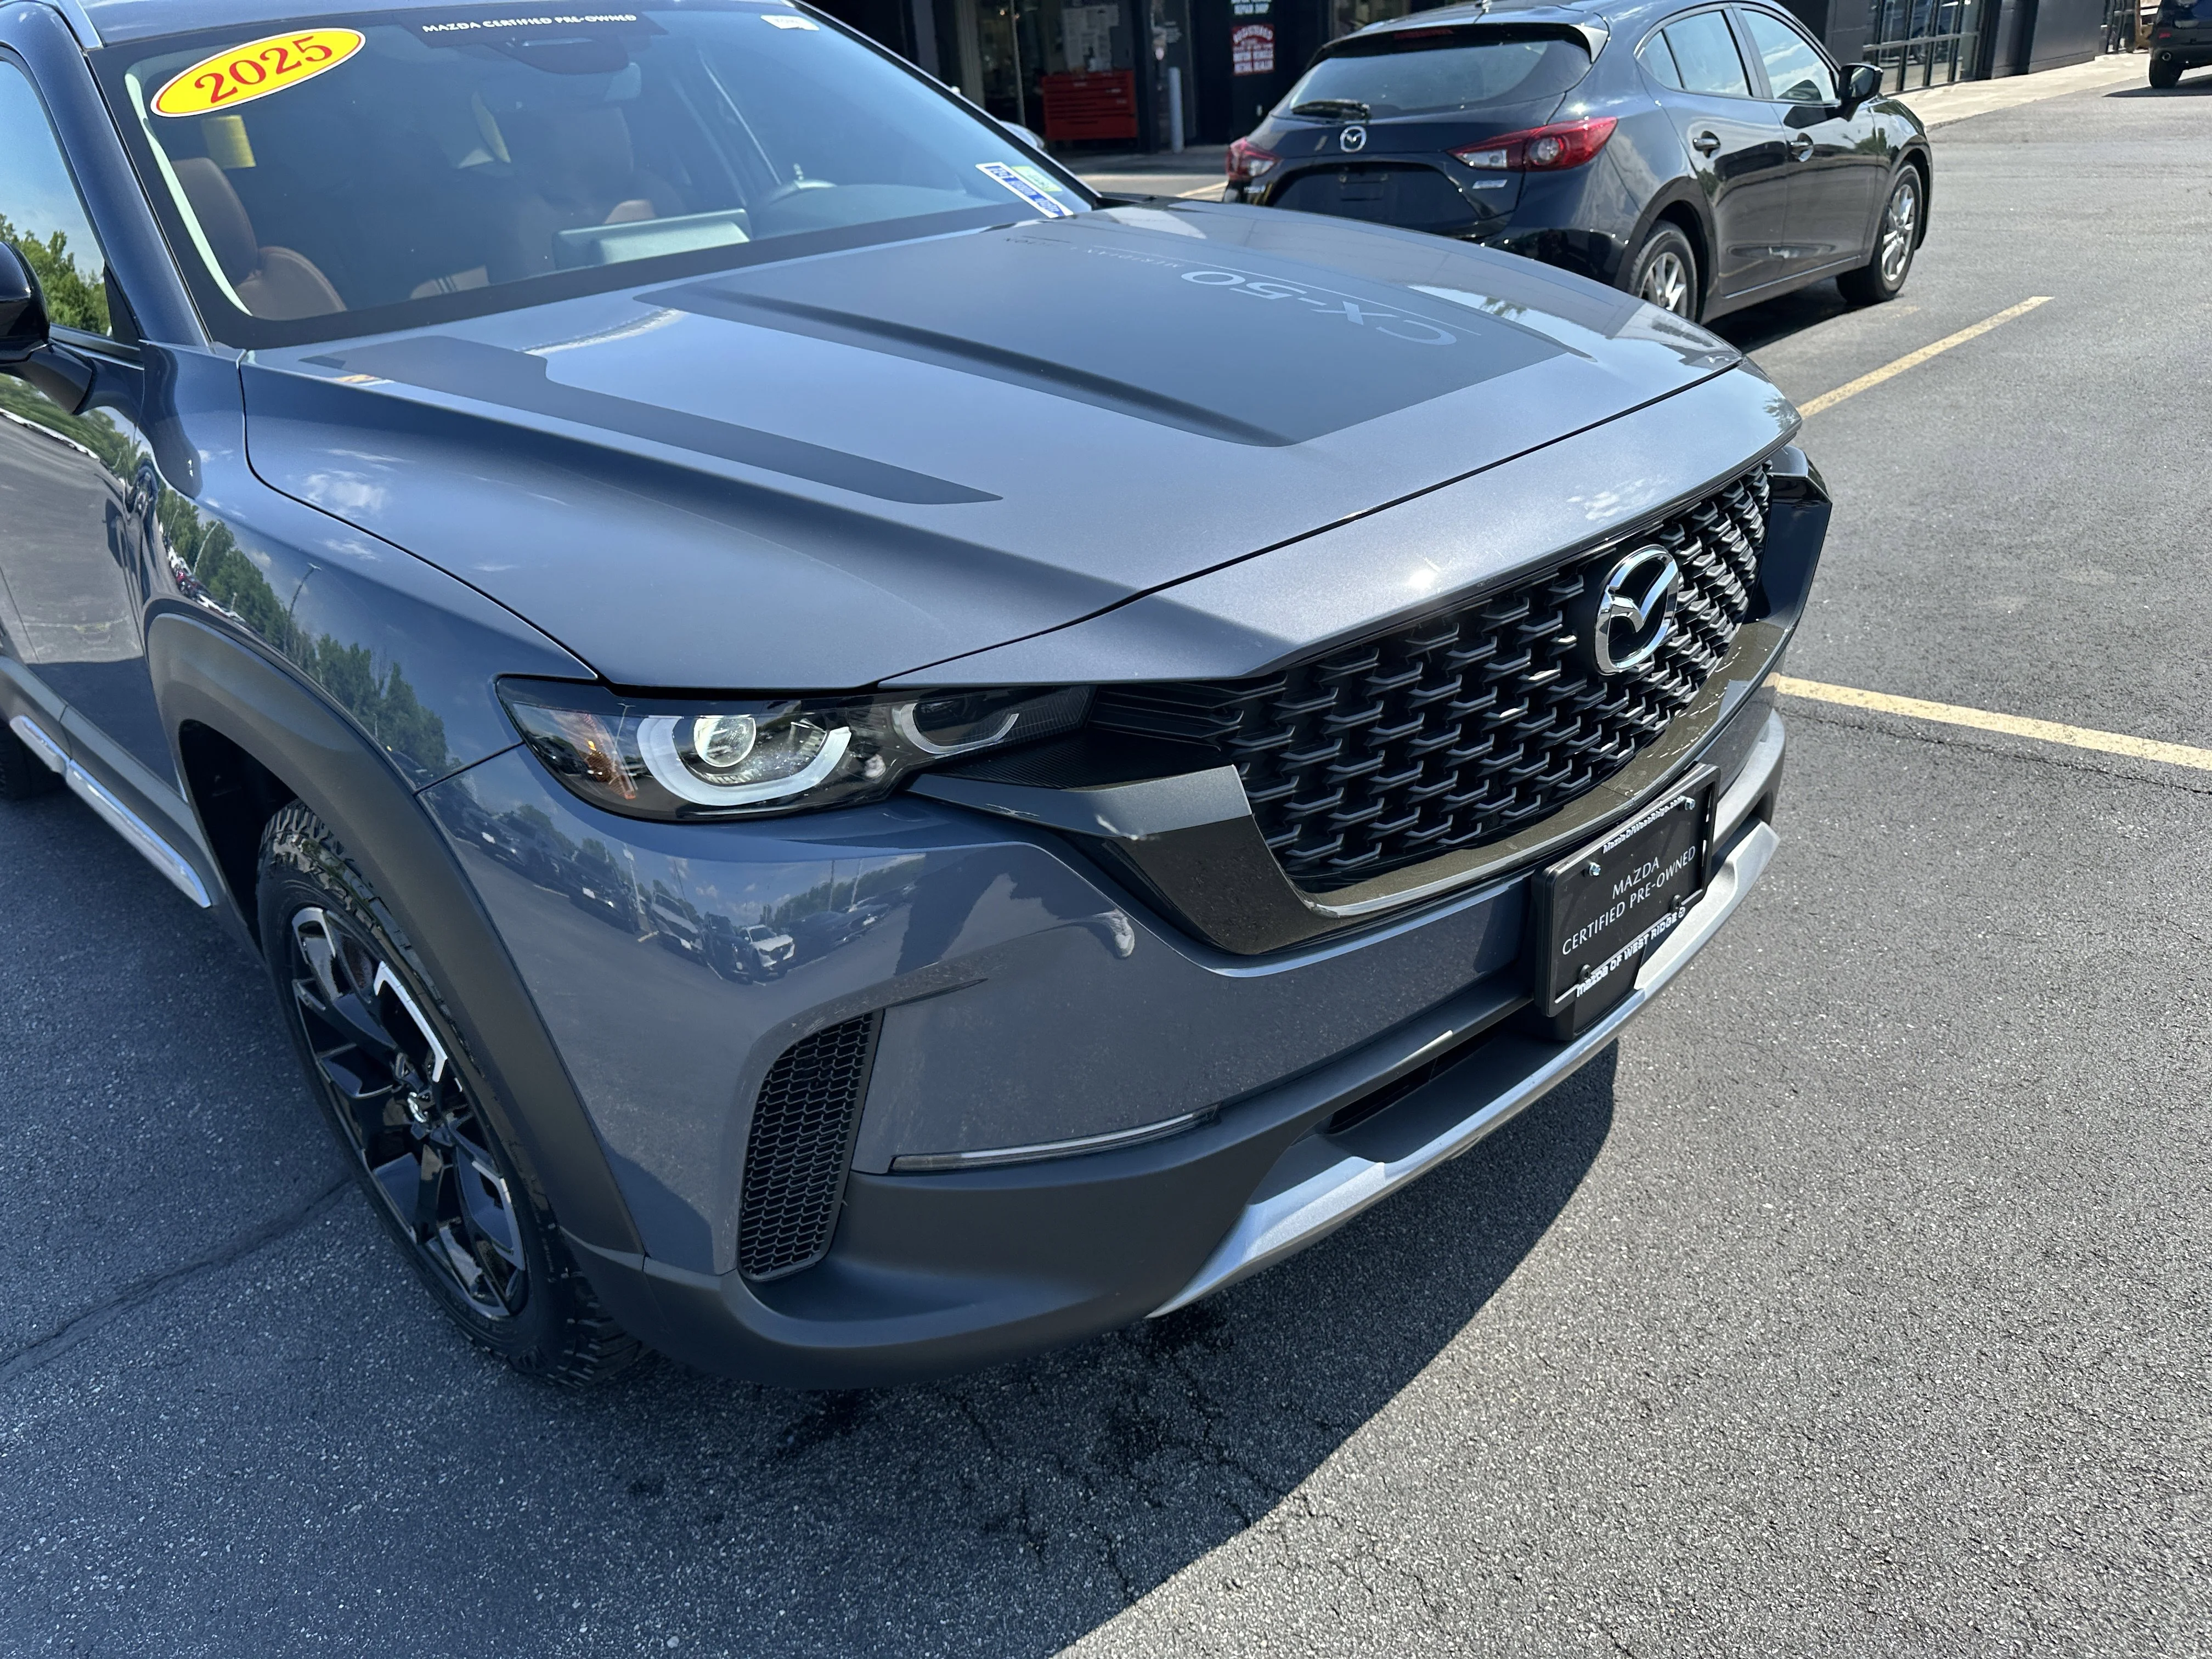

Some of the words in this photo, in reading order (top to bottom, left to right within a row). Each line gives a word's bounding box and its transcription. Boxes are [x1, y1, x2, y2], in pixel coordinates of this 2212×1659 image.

[422, 21, 481, 32] MAZDA
[482, 17, 552, 28] CERTIFIED
[555, 14, 636, 24] PRE-OWNED
[194, 36, 332, 103] 2025
[1181, 271, 1457, 346] CX-50
[1562, 901, 1625, 955] CERTIFIED
[1630, 846, 1695, 908] PRE-OWNED
[1612, 857, 1660, 899] MAZDA
[1610, 955, 1623, 970] OF
[1624, 934, 1649, 960] WEST
[1650, 912, 1677, 940] RIDGE
